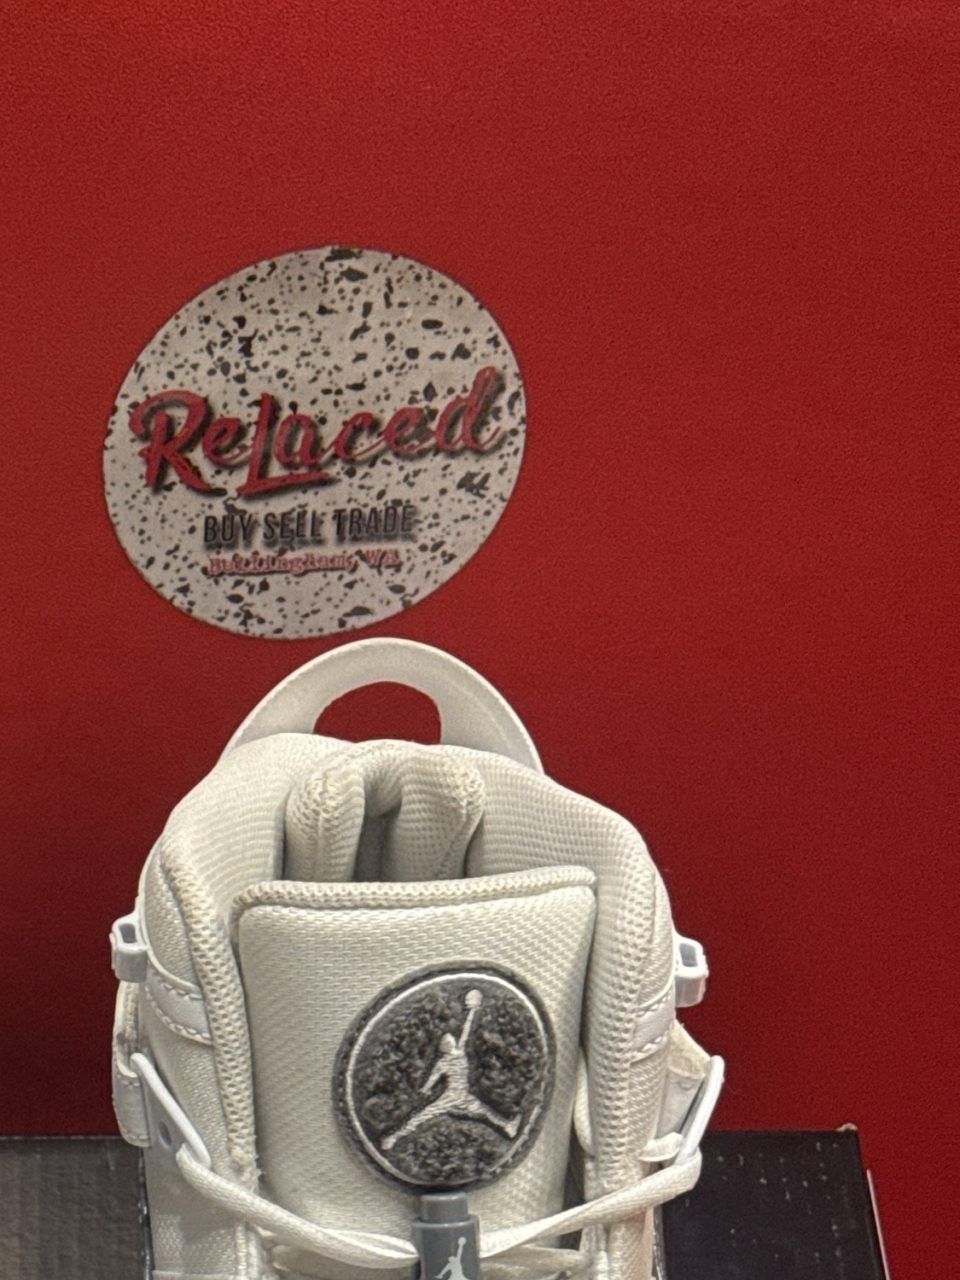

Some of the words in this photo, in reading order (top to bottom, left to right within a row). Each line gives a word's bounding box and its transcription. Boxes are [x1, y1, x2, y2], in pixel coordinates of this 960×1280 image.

[129, 365, 505, 497] ReLaced
[203, 511, 254, 545] BUY
[262, 507, 323, 542] SELL
[332, 503, 418, 539] TRADE
